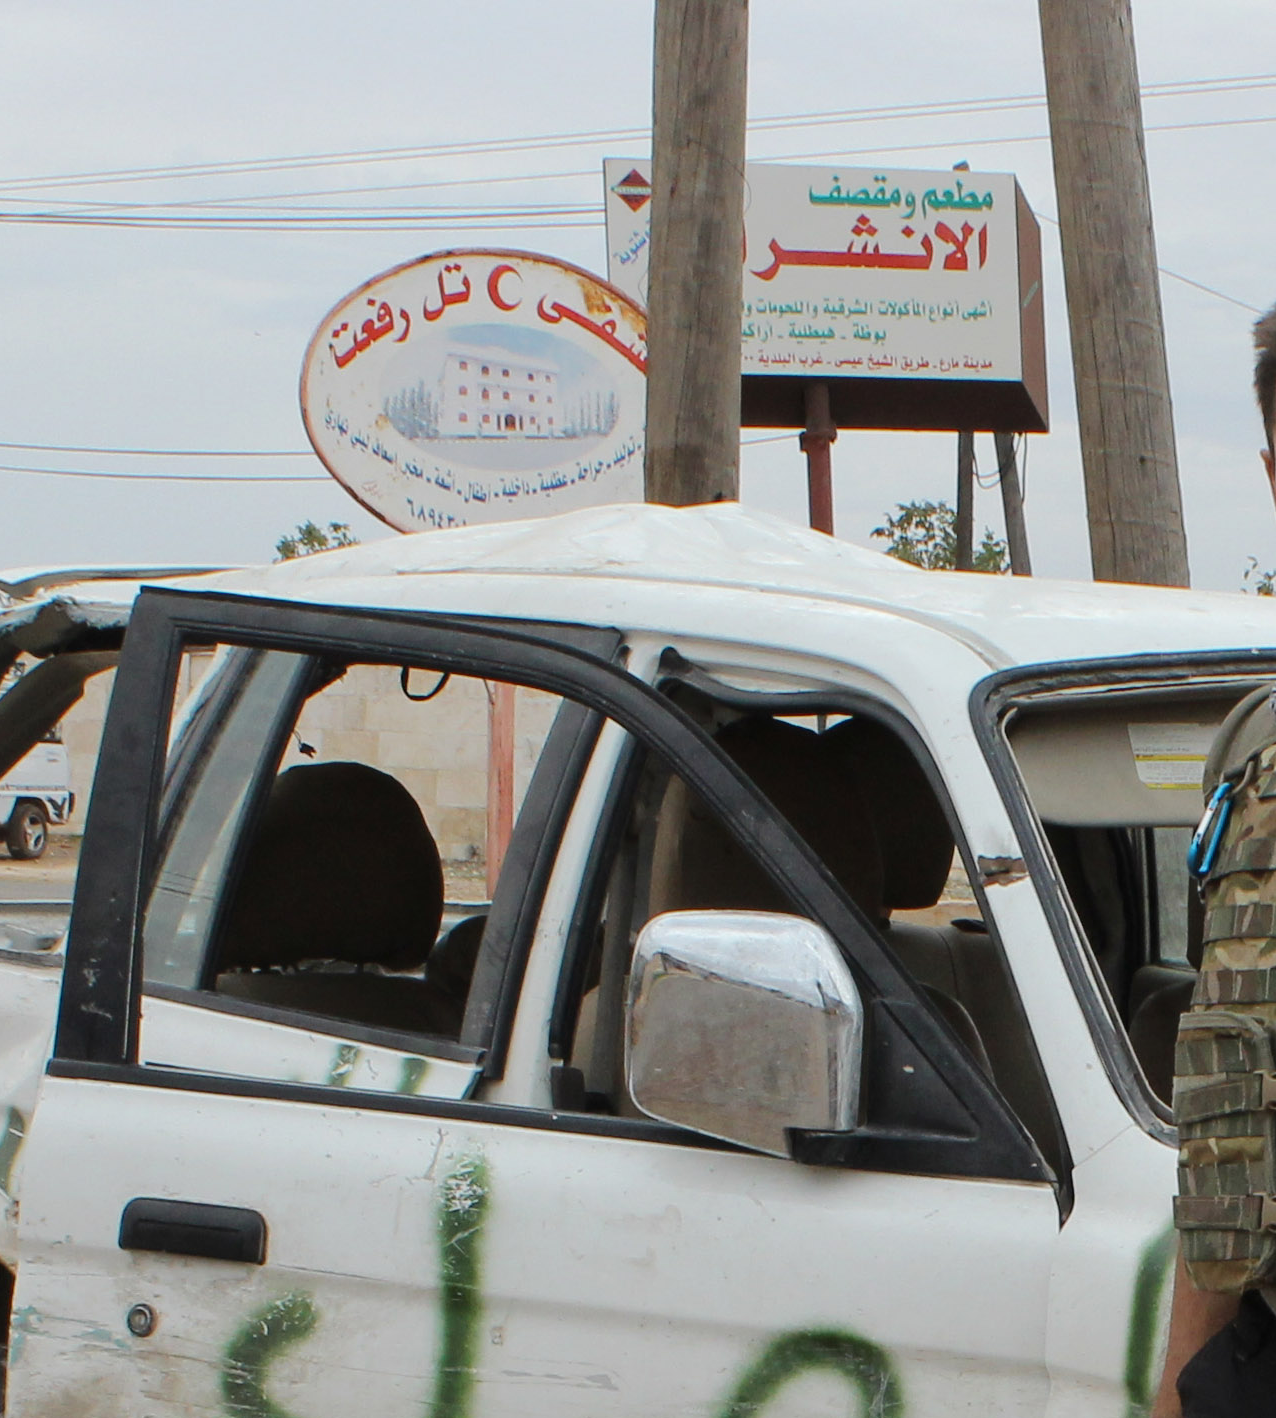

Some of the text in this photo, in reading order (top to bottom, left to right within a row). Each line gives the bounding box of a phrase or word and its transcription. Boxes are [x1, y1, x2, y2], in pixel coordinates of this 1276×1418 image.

[808, 174, 993, 219] مطعم ومقصف
[422, 262, 471, 322] تل
[822, 297, 873, 320] الشرقية
[928, 299, 960, 322] أنواع
[961, 299, 993, 321] أشهى
[327, 297, 411, 370] رفعت
[741, 321, 773, 344] أراكي
[852, 321, 887, 345] بوظة
[868, 353, 899, 371] الشيخ
[900, 355, 930, 373] طريق
[939, 356, 960, 373] مارع
[963, 354, 993, 373] مدينة
[612, 435, 636, 468] توليد
[577, 459, 605, 482] جراحة
[499, 477, 531, 504] داخلية
